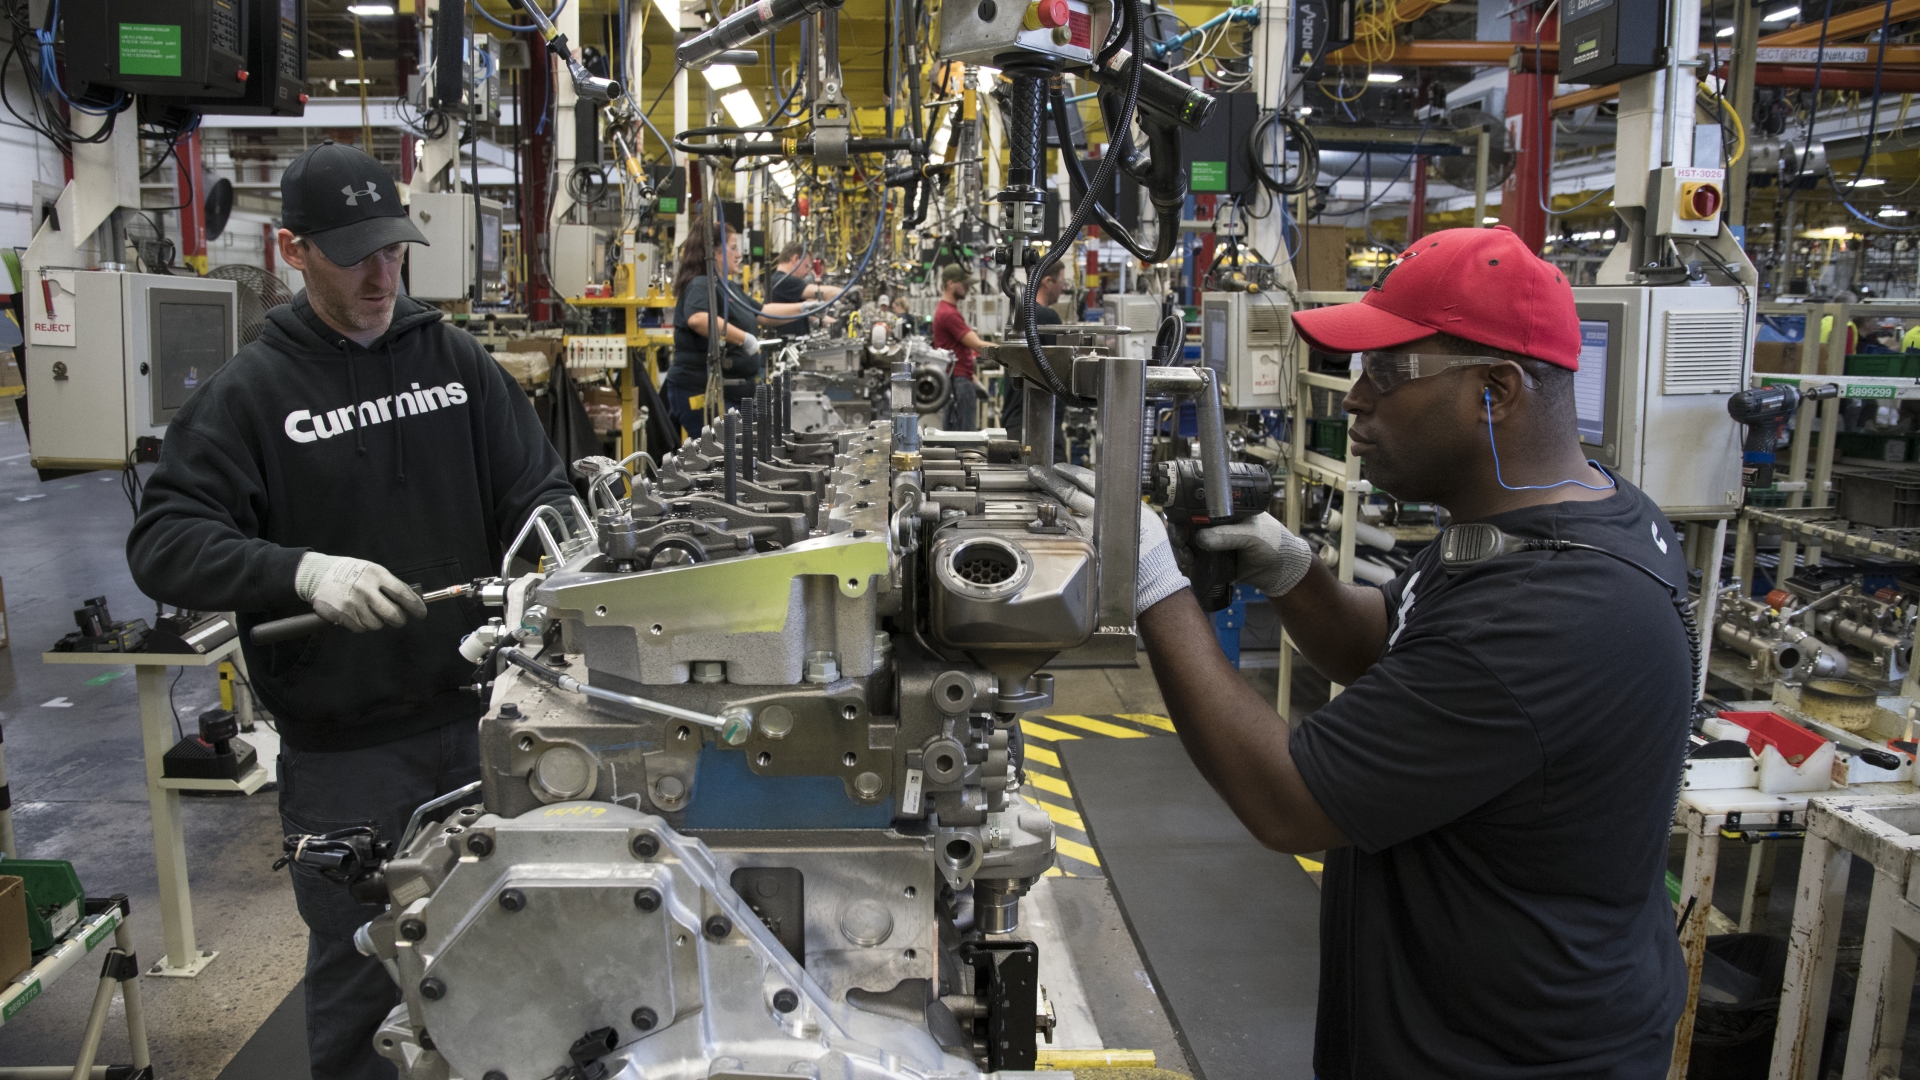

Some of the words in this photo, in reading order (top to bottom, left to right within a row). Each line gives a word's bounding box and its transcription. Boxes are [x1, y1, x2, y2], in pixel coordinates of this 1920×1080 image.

[1677, 169, 1722, 178] HST-3026
[34, 323, 71, 332] REJECT
[1849, 387, 1892, 398] 3899299
[284, 382, 468, 443] Cummins
[7, 985, 38, 1016] 3693775
